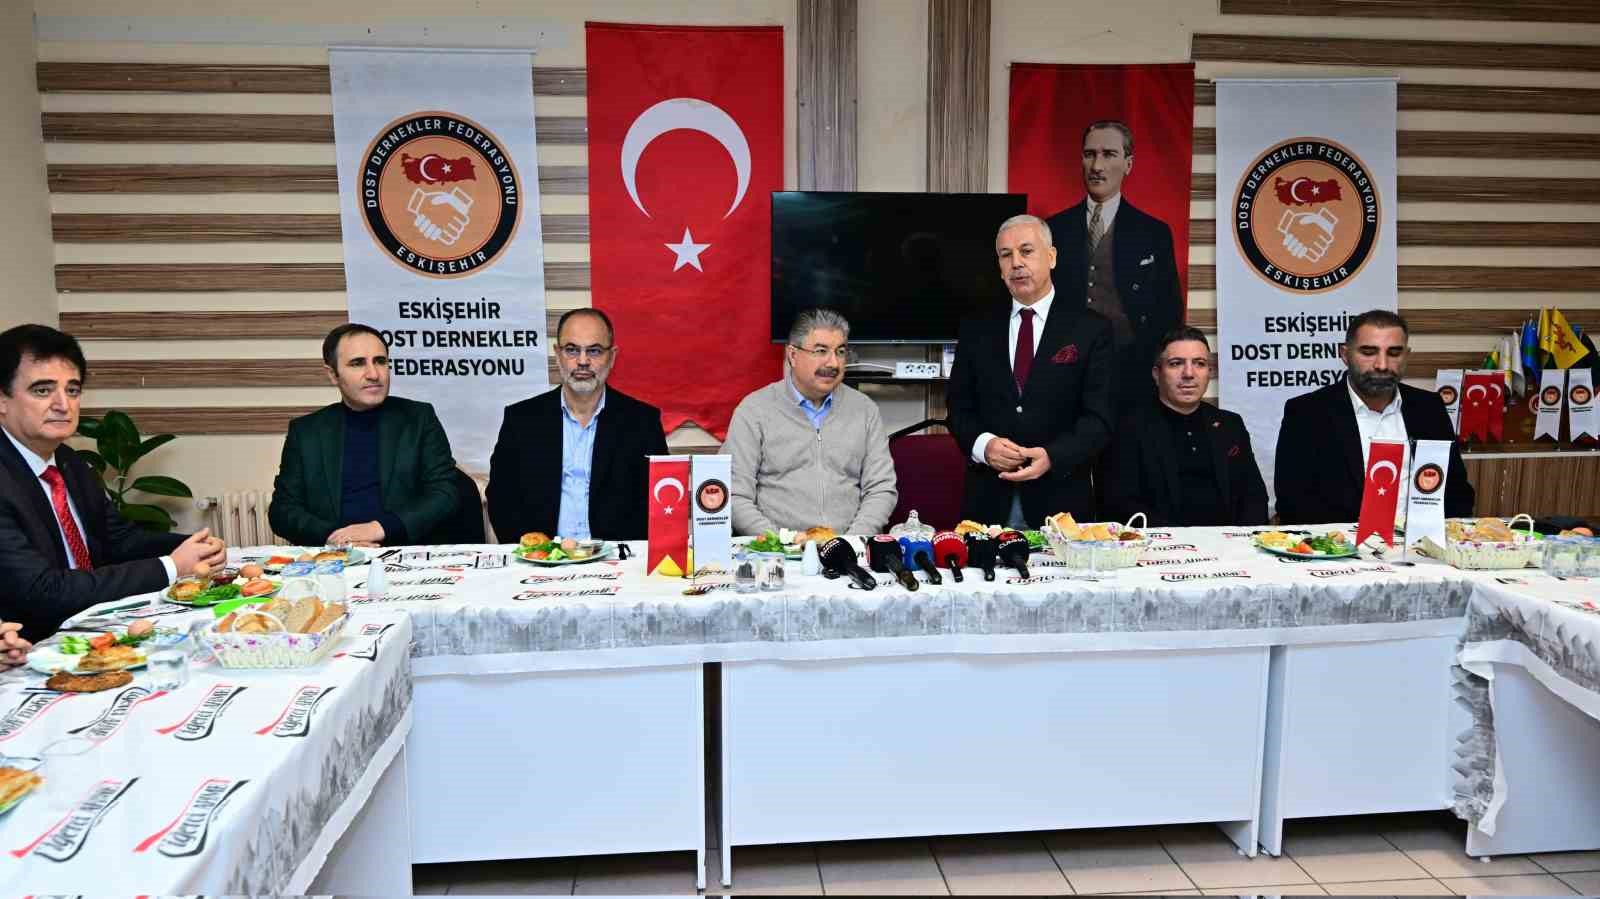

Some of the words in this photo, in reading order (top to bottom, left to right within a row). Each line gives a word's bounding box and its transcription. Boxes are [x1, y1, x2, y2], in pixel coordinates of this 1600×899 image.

[364, 169, 378, 208] DOST
[374, 118, 442, 165] DERNEKLER
[447, 121, 517, 205] FEDERASYONU
[1238, 192, 1253, 229] DOST
[1247, 144, 1313, 189] DERNEKLER
[1318, 145, 1376, 223] FEDERASYONU
[396, 246, 488, 273] ESKİŞEHİR
[399, 296, 501, 325] ESKİŞEHİR
[1264, 312, 1354, 337] ESKİŞEHİ
[381, 330, 416, 348] OST
[422, 330, 539, 348] DERNEKLER
[1231, 344, 1282, 360] DOST
[1288, 343, 1342, 360] DERN
[1247, 370, 1349, 387] FEDERASY
